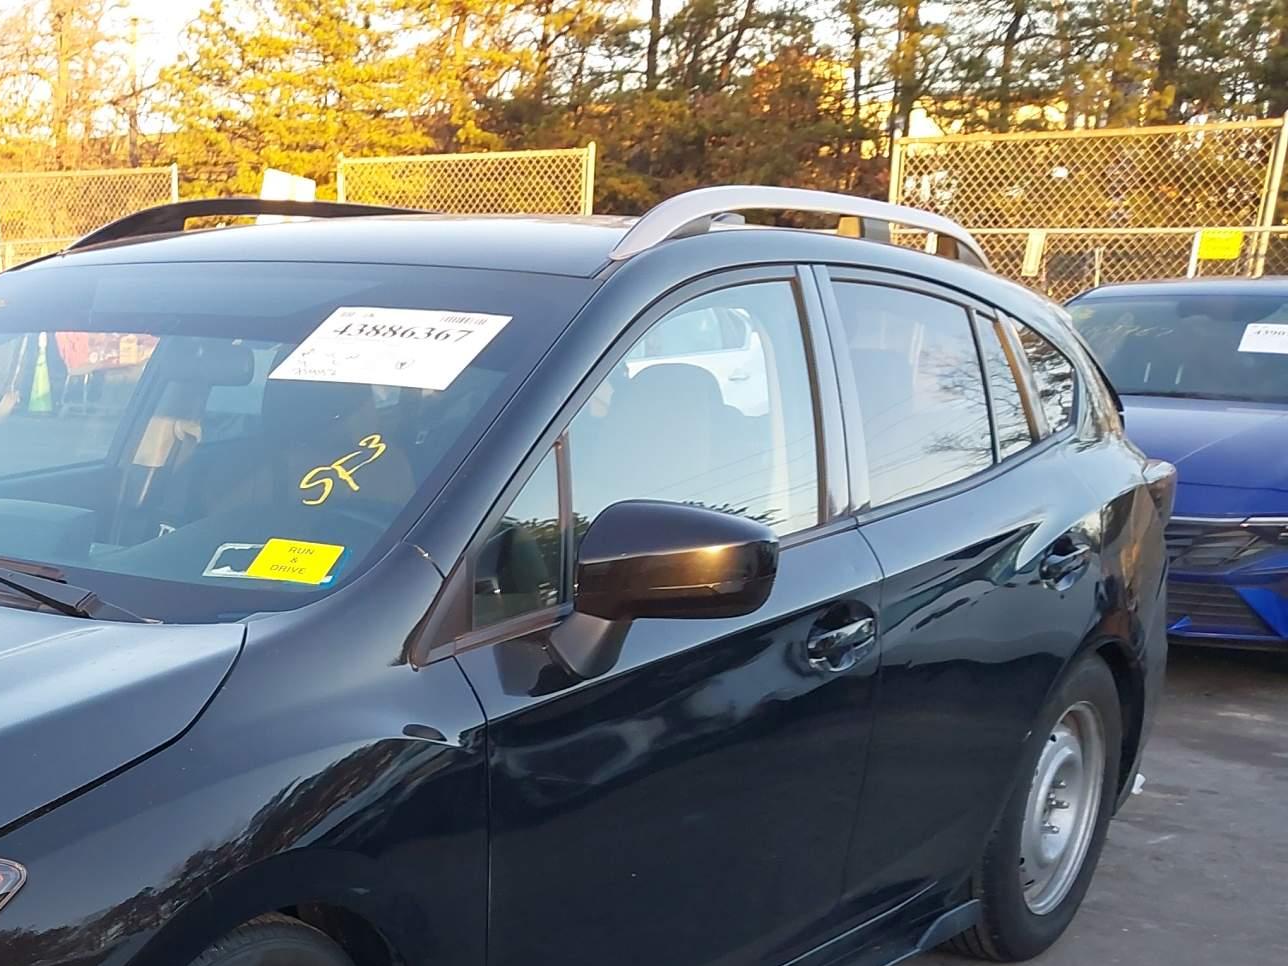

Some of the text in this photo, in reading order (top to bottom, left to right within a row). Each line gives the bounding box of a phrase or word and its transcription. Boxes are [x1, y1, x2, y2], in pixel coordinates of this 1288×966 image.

[332, 322, 475, 343] 43886367
[287, 545, 316, 556] RUN
[289, 556, 299, 564] &
[269, 563, 307, 575] DRIVE
